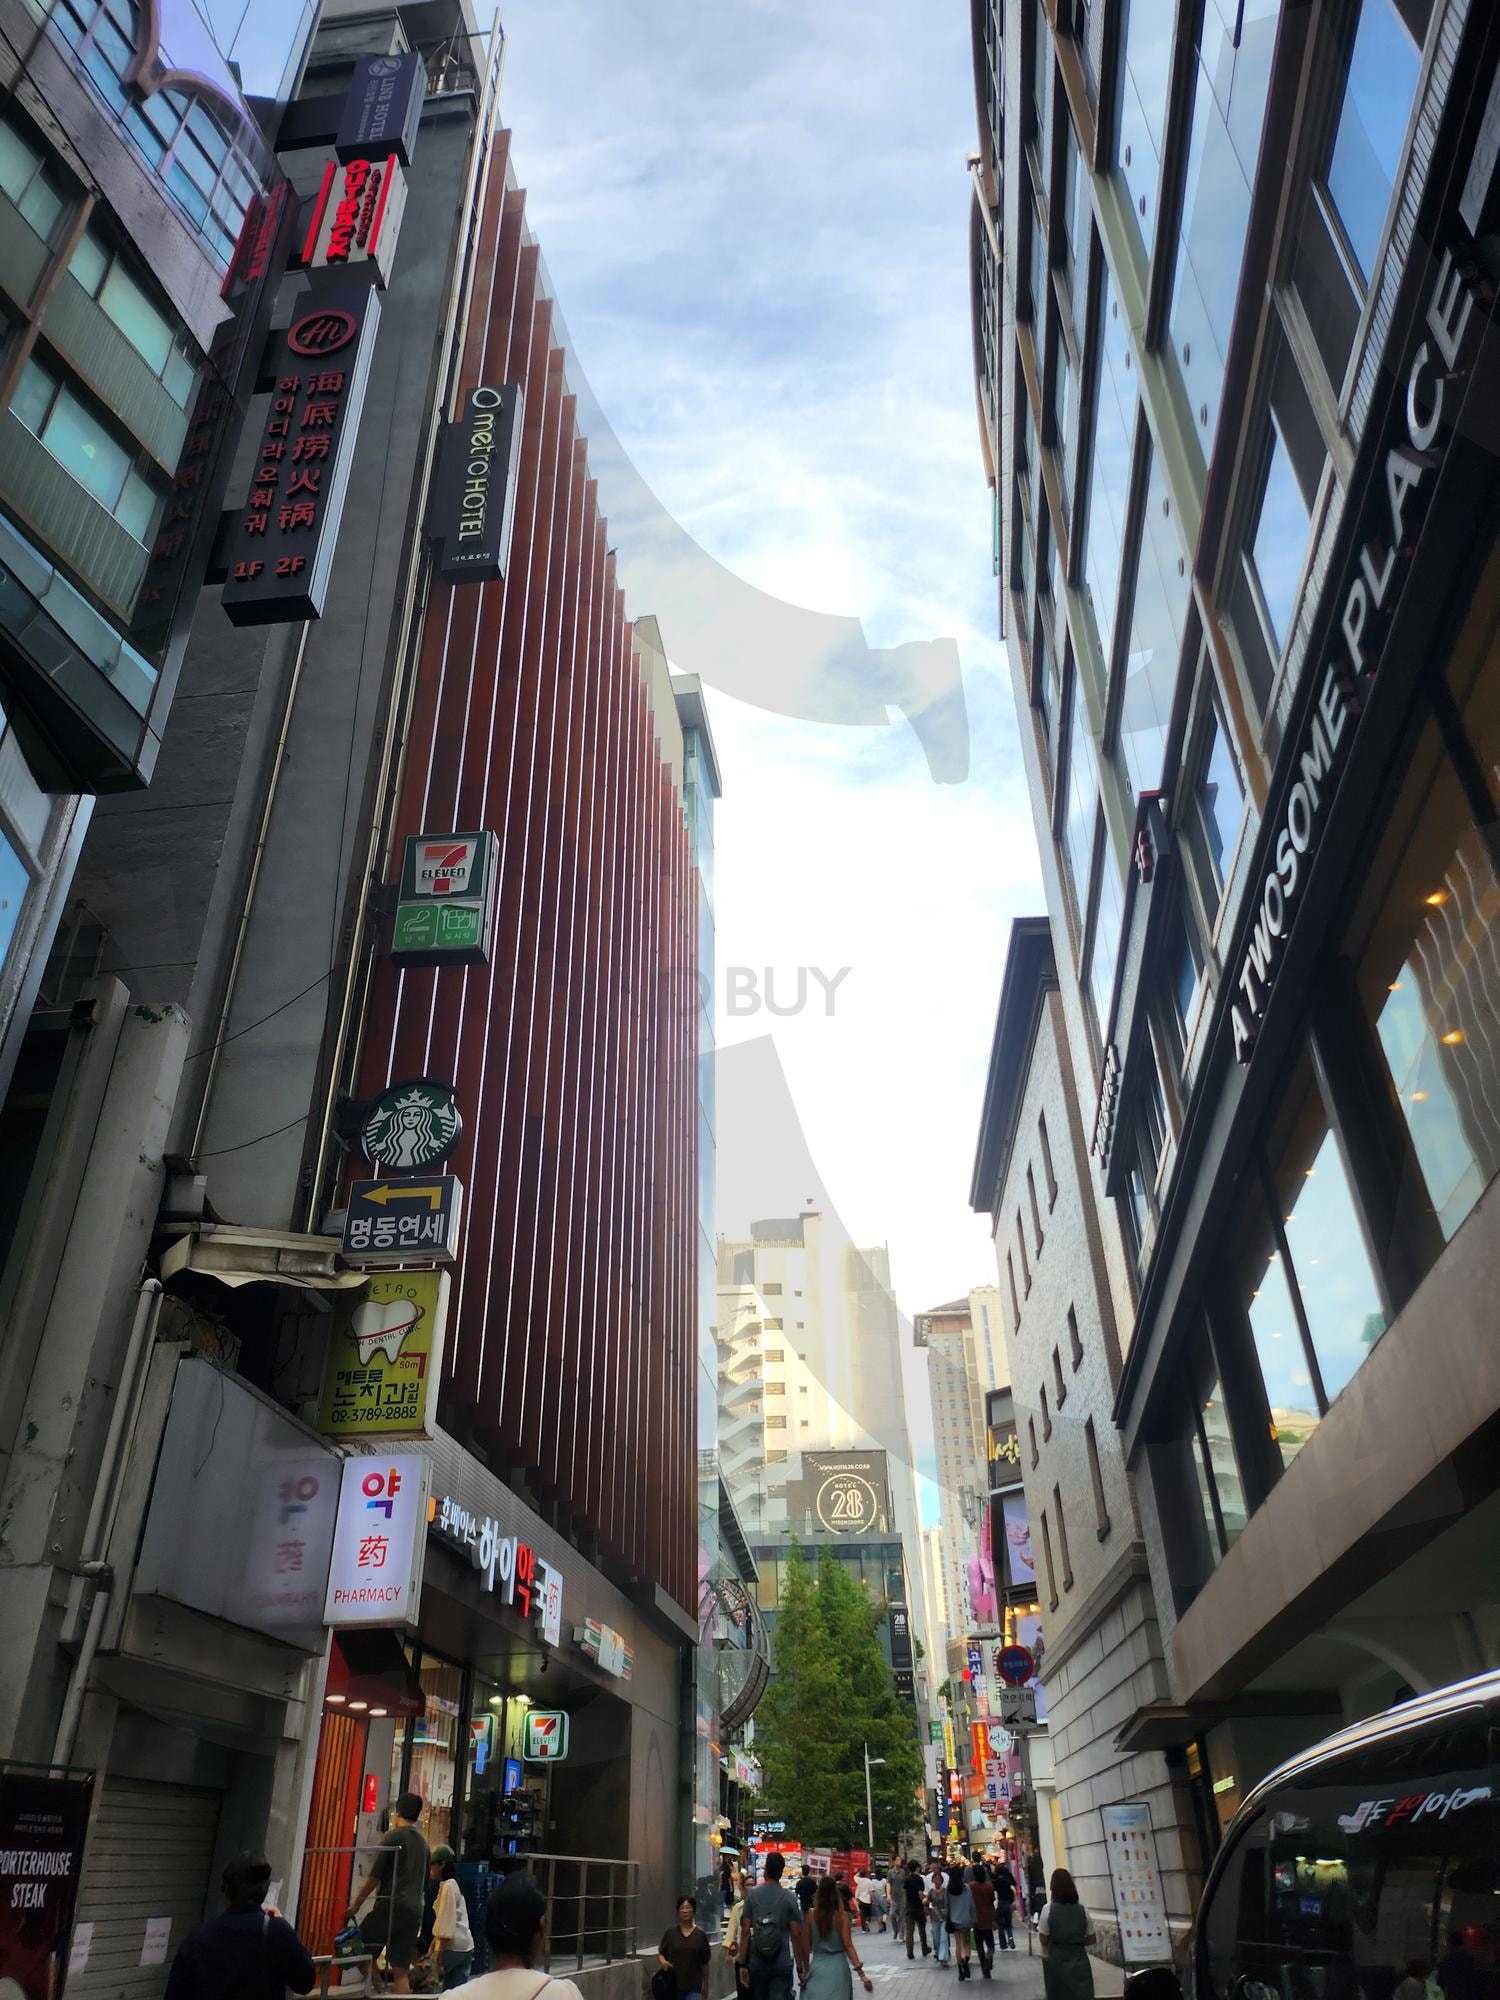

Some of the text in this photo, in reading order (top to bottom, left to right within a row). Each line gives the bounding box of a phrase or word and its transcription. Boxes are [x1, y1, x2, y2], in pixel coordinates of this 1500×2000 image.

[369, 104, 392, 141] HOTEL
[326, 160, 371, 262] OUTBACK
[243, 375, 302, 534] 하이디라오훠궈
[278, 369, 345, 529] 海底捞火锅
[459, 475, 490, 542] HOTEL
[234, 556, 305, 579] 1F 2F
[1231, 247, 1474, 1065] A TWOSOME PLACE
[350, 1213, 445, 1249] 명동연세
[368, 1333, 396, 1346] DENTAL
[337, 1369, 383, 1385] 메트로
[400, 1361, 418, 1369] 50m
[331, 1406, 417, 1424] 02-3789-2882
[362, 1468, 402, 1519] 약
[831, 1489, 864, 1519] 28
[358, 1536, 390, 1568] 药
[440, 1495, 550, 1629] 휴베이스 하이약국
[334, 1587, 402, 1604] PHARMACY
[986, 1761, 1007, 1778] 도장
[11, 1883, 48, 1908] STEAK
